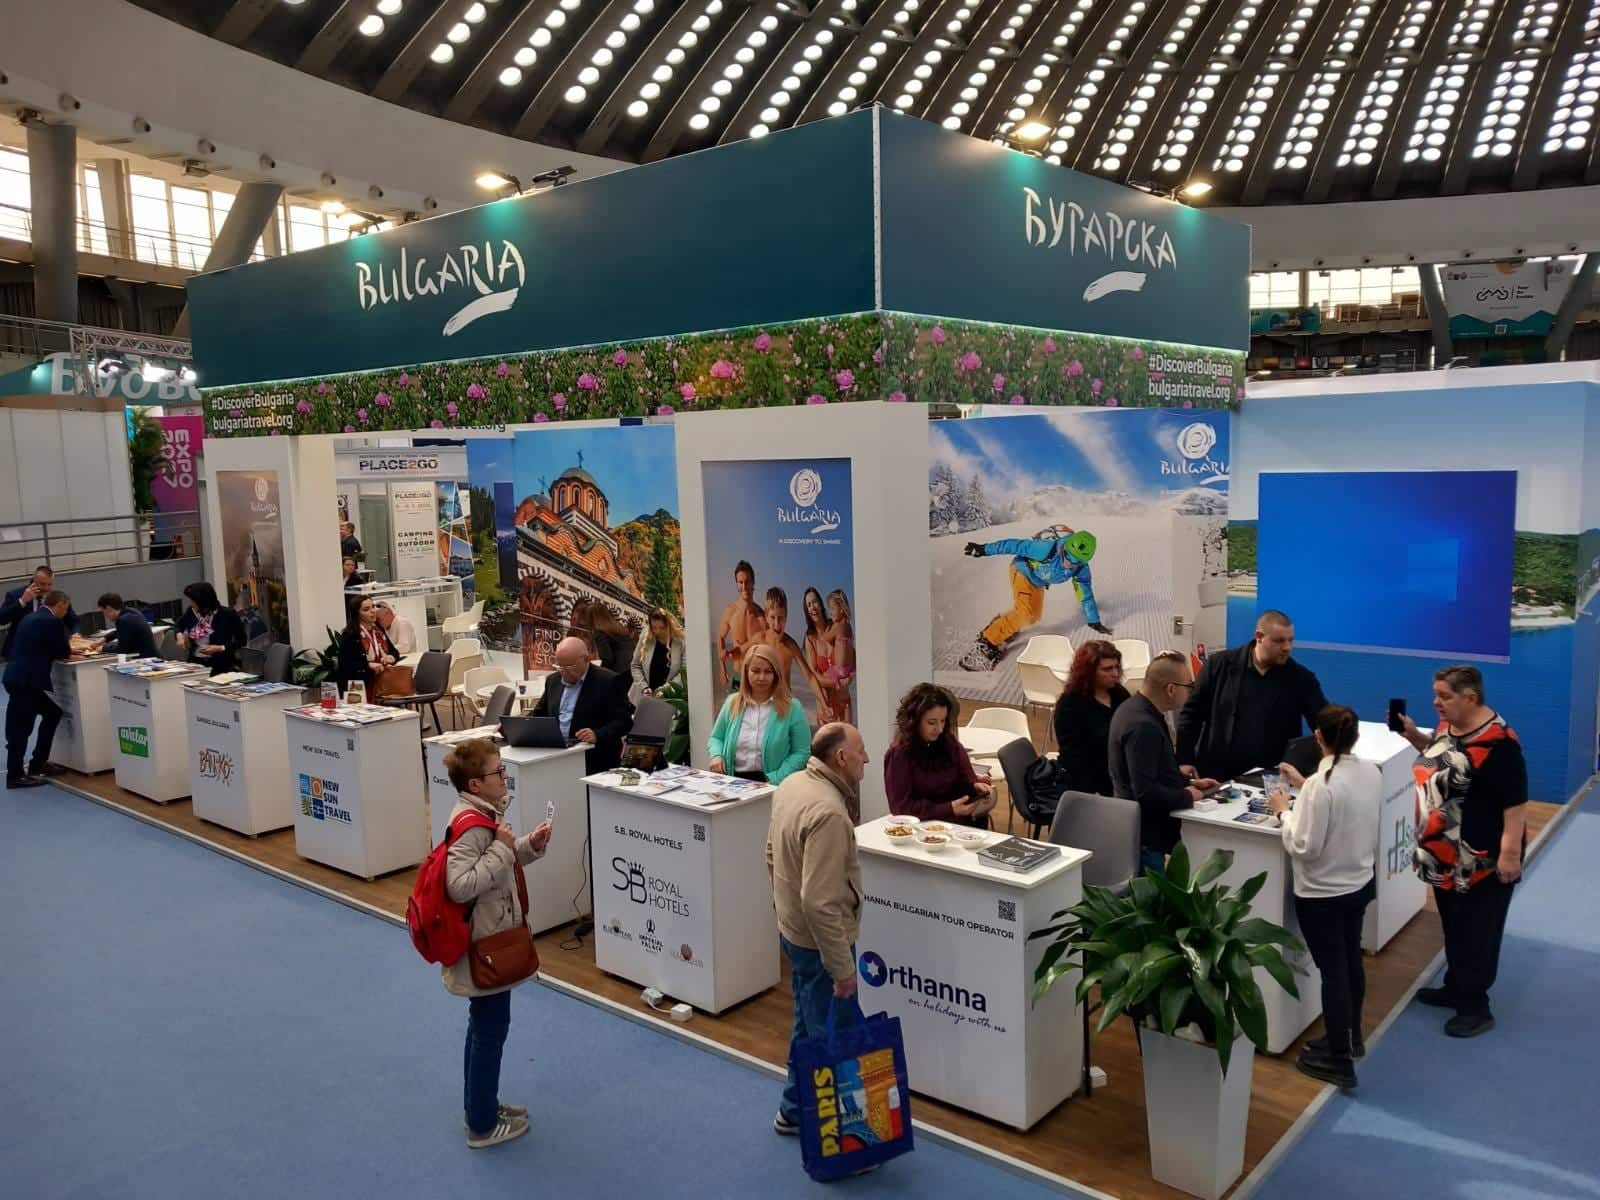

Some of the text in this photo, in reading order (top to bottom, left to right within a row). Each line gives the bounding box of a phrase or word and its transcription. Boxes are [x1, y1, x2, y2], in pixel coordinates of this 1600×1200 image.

[1023, 186, 1177, 272] БУГАРСКА
[355, 239, 525, 312] BULGARIA
[1148, 354, 1233, 380] #DiscoverBulgaria
[211, 390, 295, 411] #DiscoverBulgaria
[1148, 378, 1231, 402] bulgariatravel.org
[213, 411, 293, 433] bulgariatravel.org
[174, 429, 193, 488] EXPO
[359, 459, 439, 471] PLACE2GO
[777, 506, 841, 525] BULGARIA
[535, 628, 561, 641] FIND
[322, 779, 339, 793] NEW
[323, 792, 338, 806] SUN
[324, 805, 352, 822] TRAVEL
[614, 825, 683, 851] S.B. ROYAL HOTELS
[648, 877, 684, 899] ROYAL
[649, 893, 690, 917] HOTELS
[863, 894, 1015, 940] HANNA BULGARIAN TOUR OPERATOR
[858, 951, 987, 1013] Orthanna
[814, 1066, 840, 1158] PARIS
